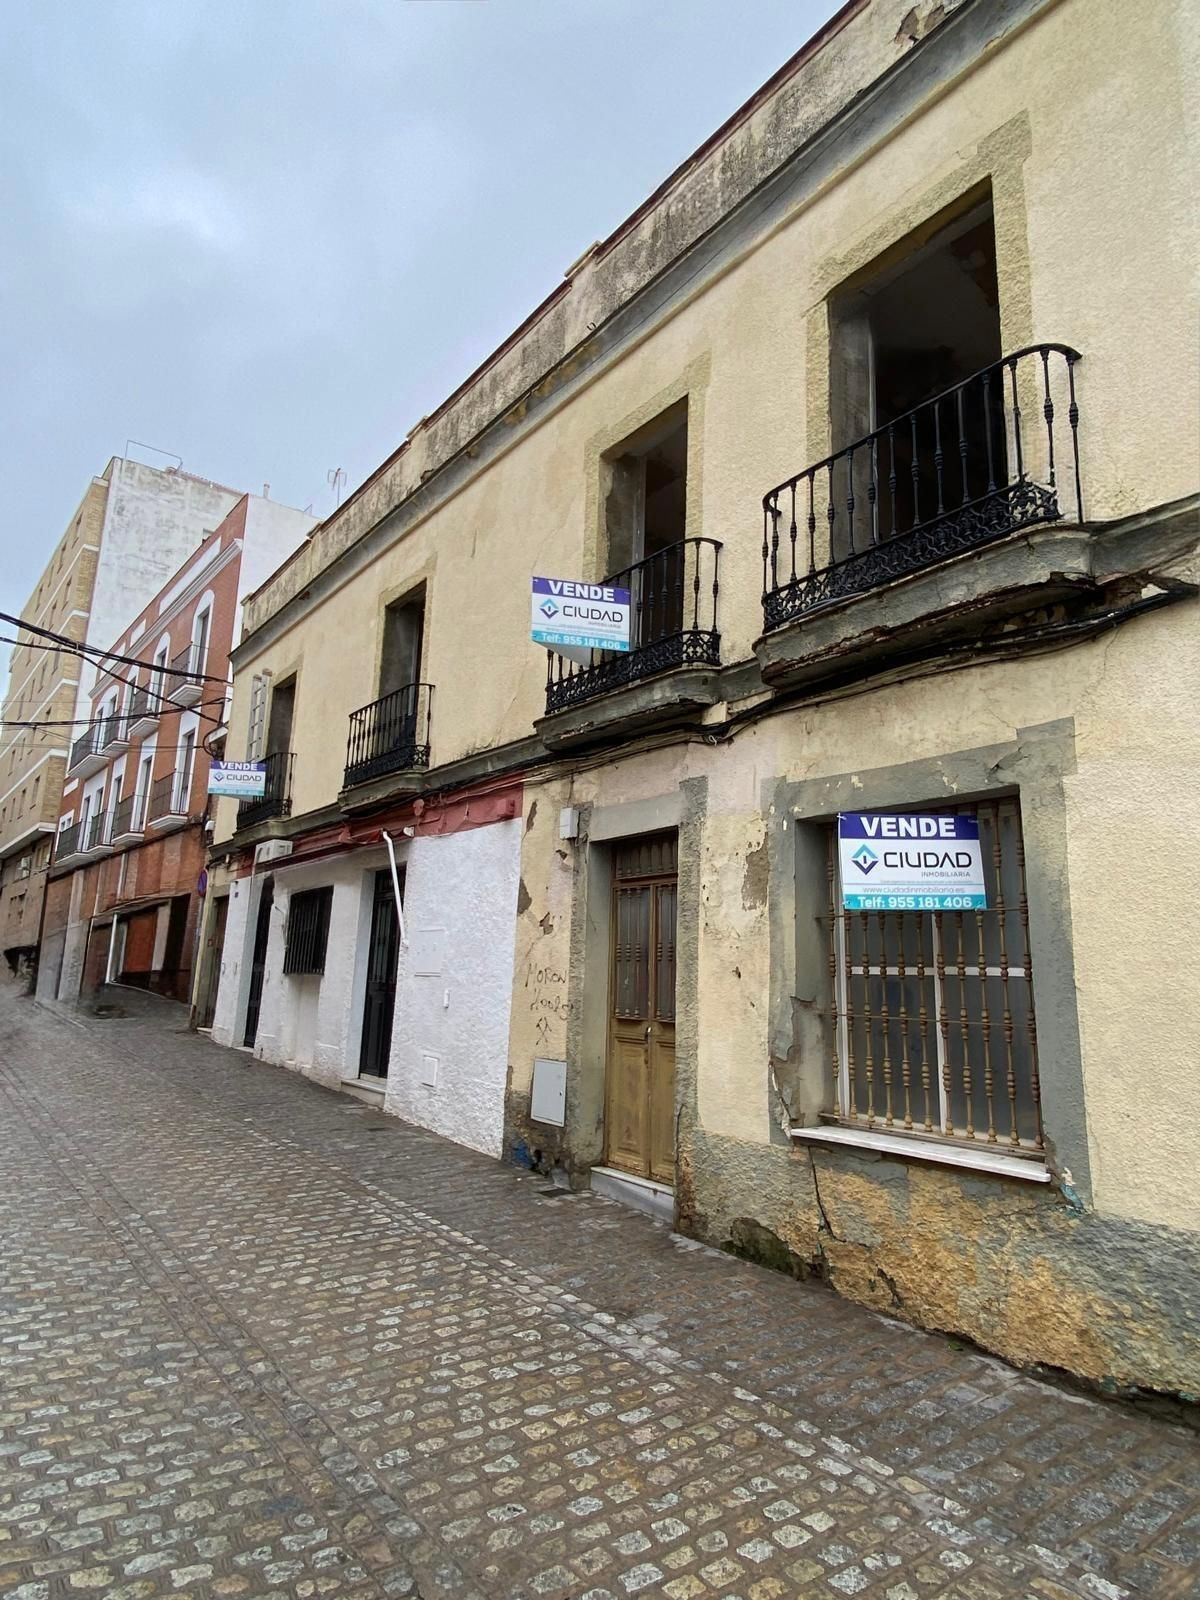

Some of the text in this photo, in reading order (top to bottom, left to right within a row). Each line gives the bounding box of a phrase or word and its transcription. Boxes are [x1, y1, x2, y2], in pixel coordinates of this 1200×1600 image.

[548, 580, 614, 602] VENDE
[563, 605, 623, 623] CIUDAD
[542, 632, 562, 643] Telf:
[564, 635, 582, 645] 955
[584, 637, 600, 647] 181
[601, 639, 621, 650] 406
[219, 762, 258, 771] VENDE
[860, 816, 957, 838] VENDE
[883, 852, 972, 868] CIUDAD
[857, 896, 973, 908] Telf: 955 181 406
